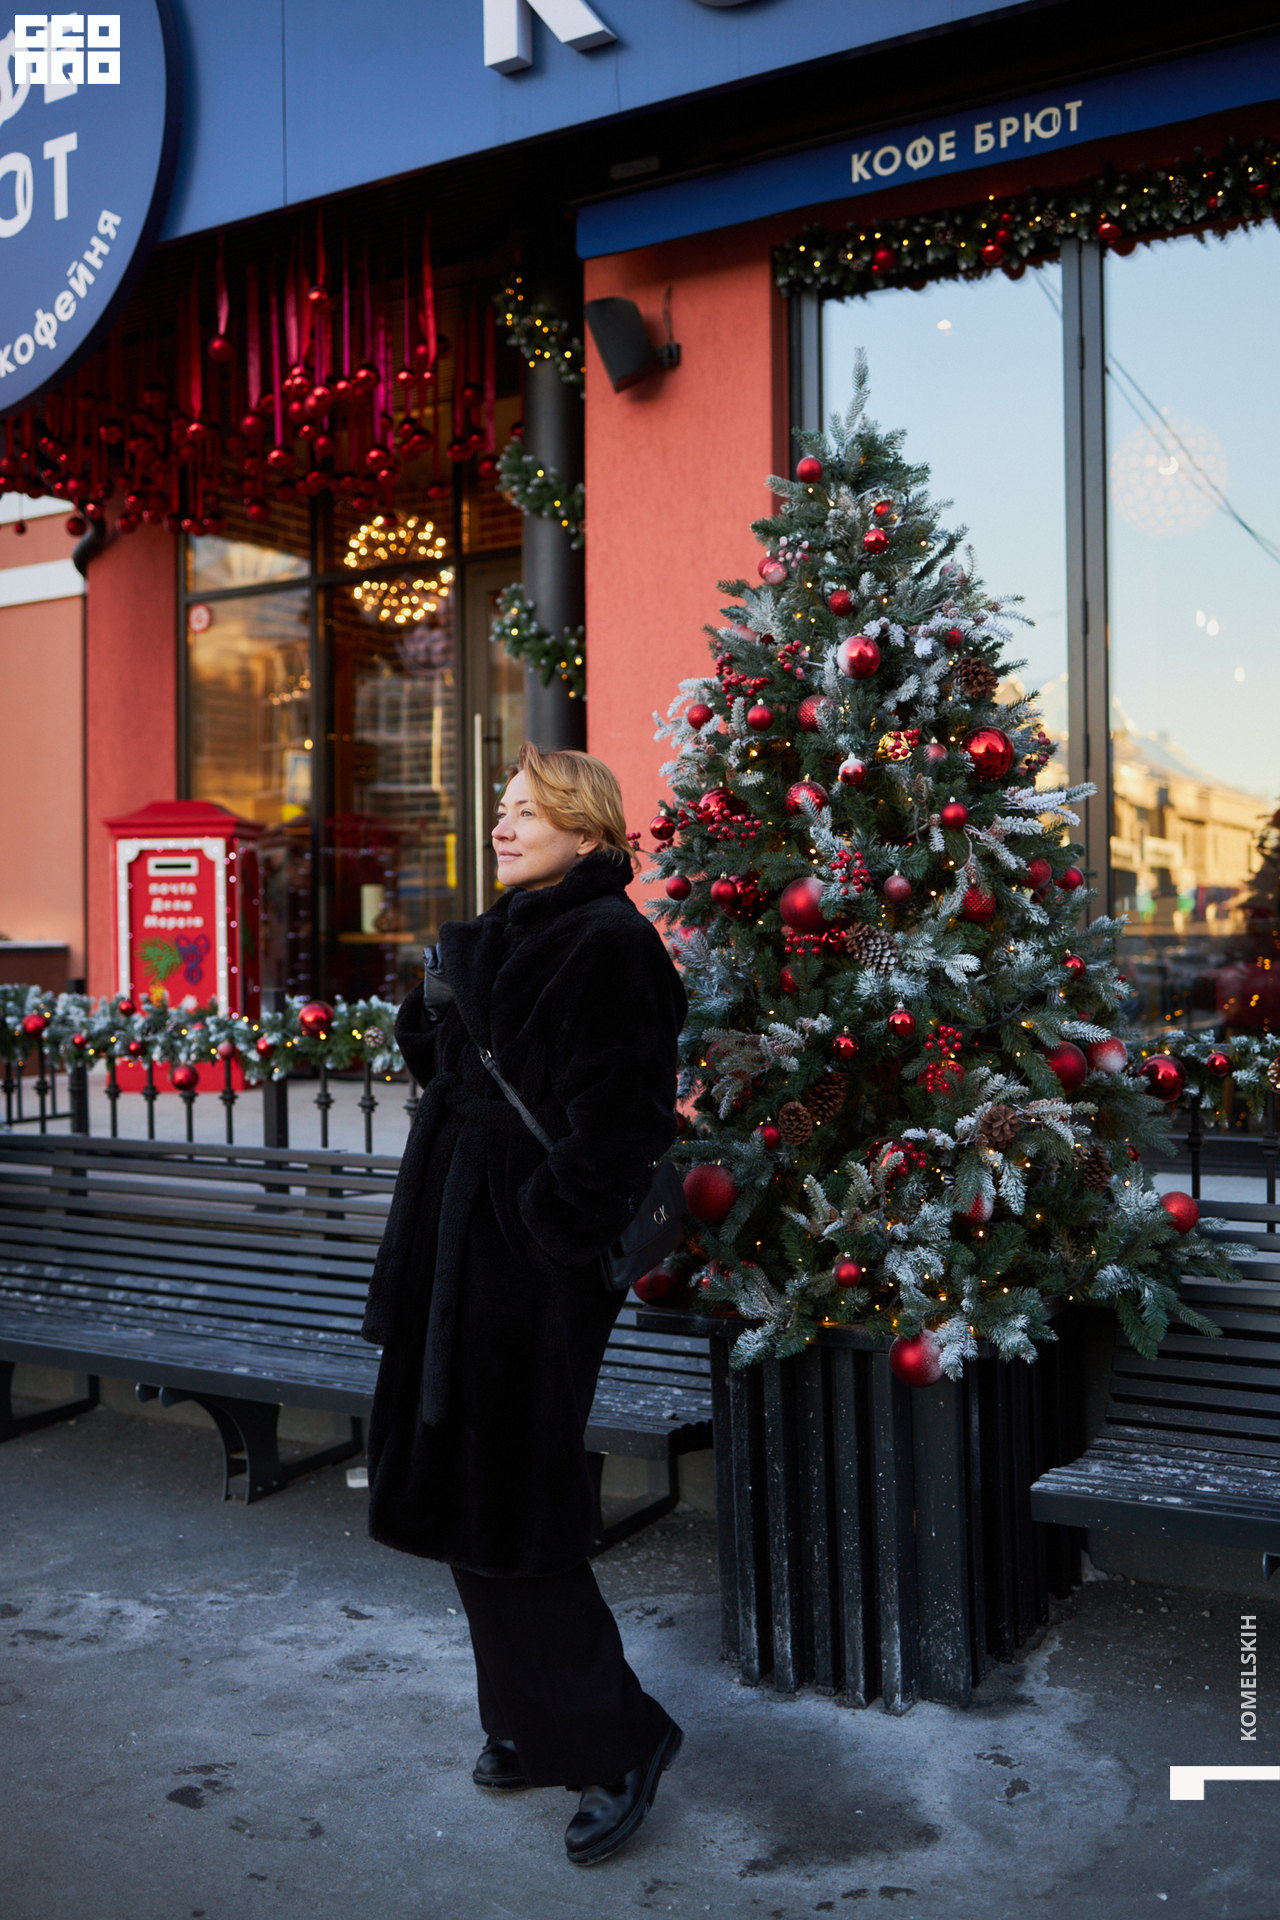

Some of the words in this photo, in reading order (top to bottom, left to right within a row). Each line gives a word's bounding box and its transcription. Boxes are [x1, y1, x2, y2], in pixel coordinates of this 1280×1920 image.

[851, 130, 956, 183] КОФЕ
[974, 100, 1082, 155] БРЮТ
[0, 209, 122, 378] кофейня
